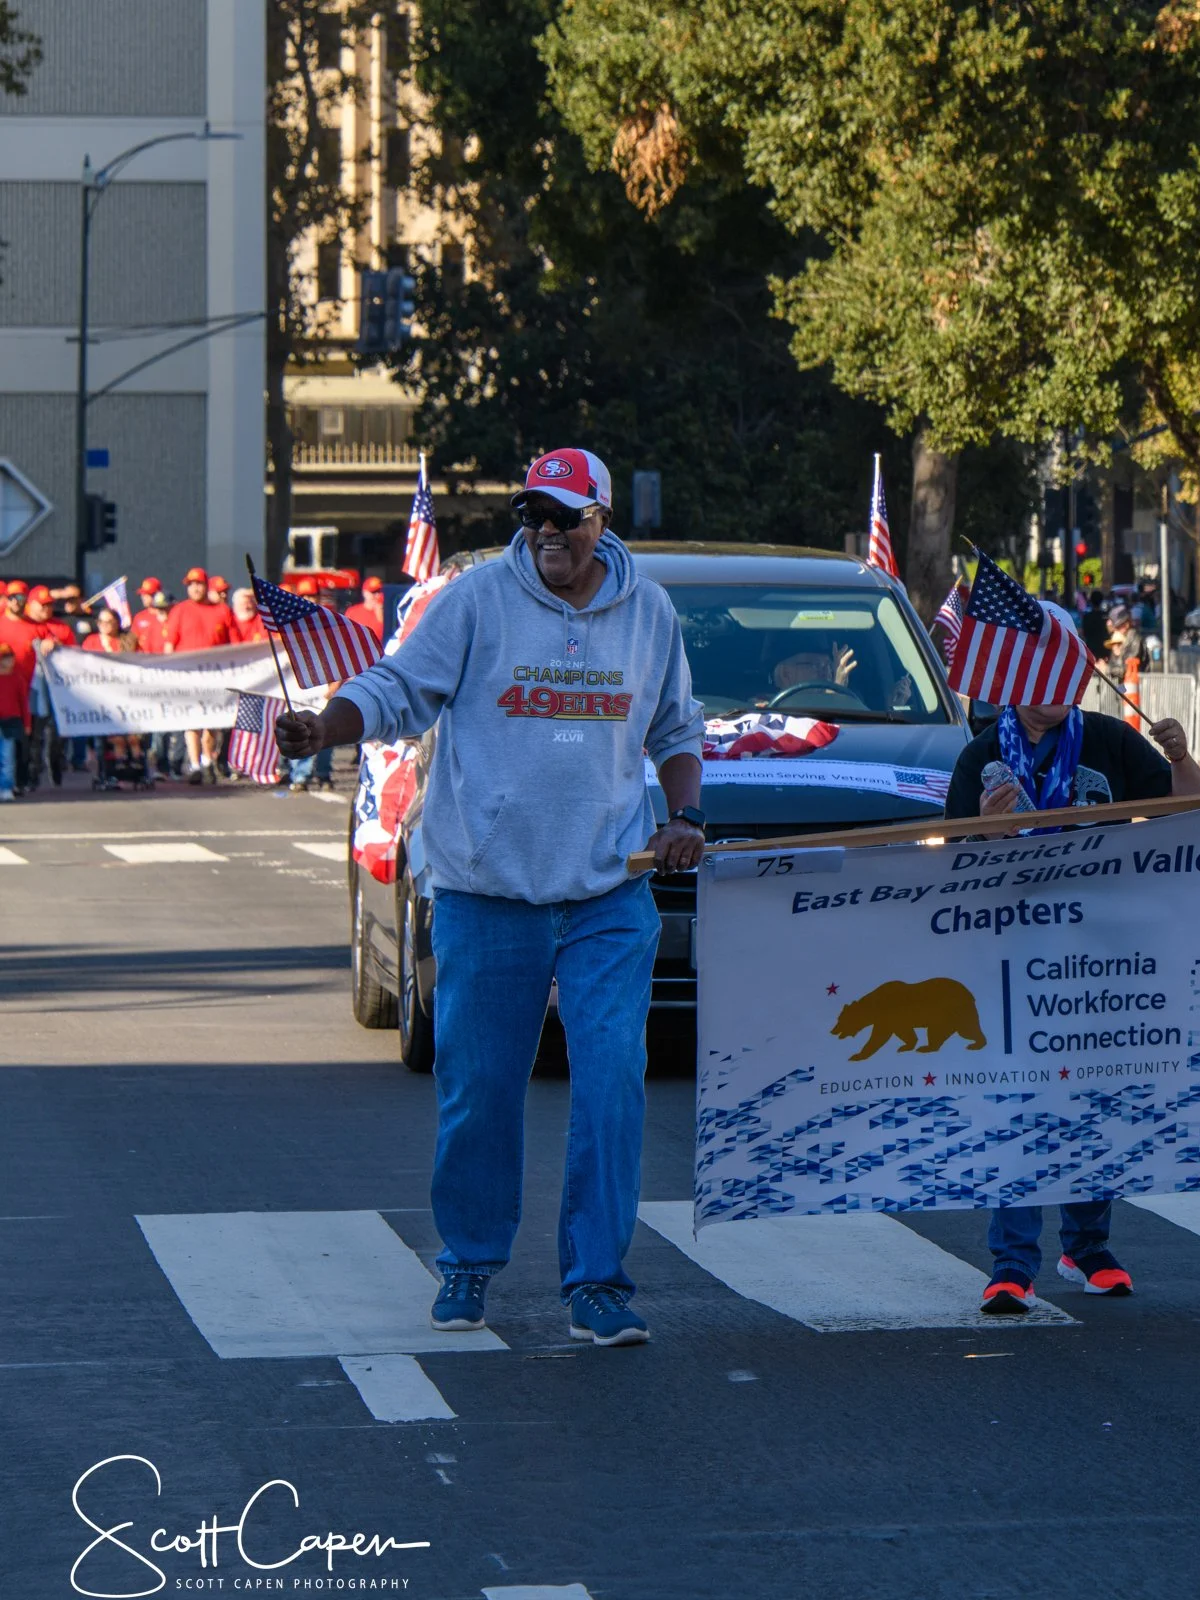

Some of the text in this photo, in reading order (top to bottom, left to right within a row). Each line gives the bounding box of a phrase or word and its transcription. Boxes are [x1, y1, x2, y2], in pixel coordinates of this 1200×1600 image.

[513, 666, 623, 685] CHAMPIONS
[121, 702, 154, 724] You
[160, 700, 191, 721] For
[497, 685, 633, 719] 49ERS
[776, 771, 826, 782] Serving
[832, 774, 892, 786] Veterans
[757, 855, 795, 877] 75
[950, 841, 1076, 870] District
[792, 888, 862, 914] East
[870, 884, 935, 903] Bay
[940, 871, 1007, 894] and
[1011, 854, 1122, 885] Silicon
[930, 899, 1083, 934] Chapters
[1026, 952, 1157, 981] California
[1027, 988, 1166, 1017] Workforce
[1028, 1022, 1181, 1055] Connection
[820, 1061, 1180, 1094] EDUCATION INNOVATION OPPORTUNITY
